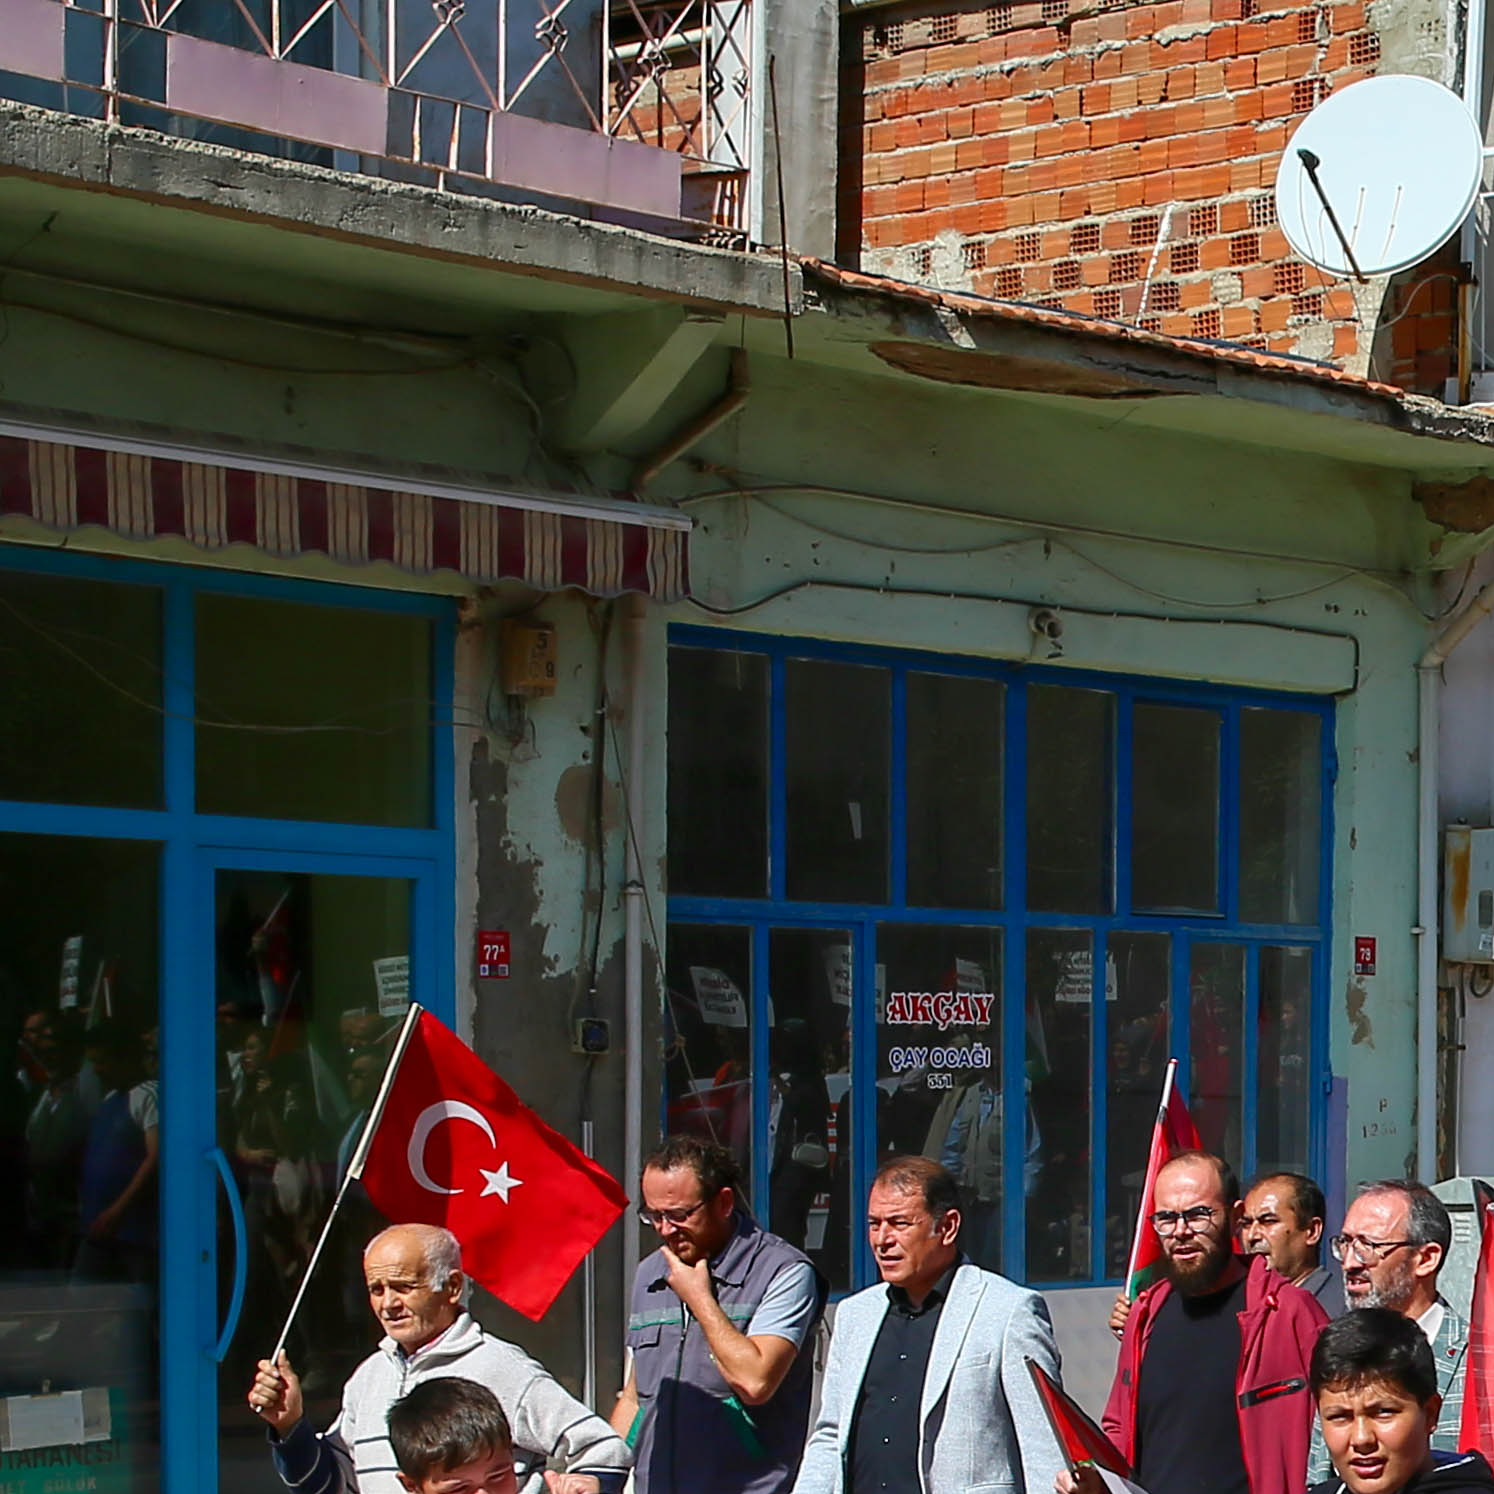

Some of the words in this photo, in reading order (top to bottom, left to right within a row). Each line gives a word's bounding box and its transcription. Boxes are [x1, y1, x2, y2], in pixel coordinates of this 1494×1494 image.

[887, 992, 994, 1030] AKÇAY
[889, 1047, 929, 1071] ÇAY
[928, 1043, 992, 1069] OCAĞI
